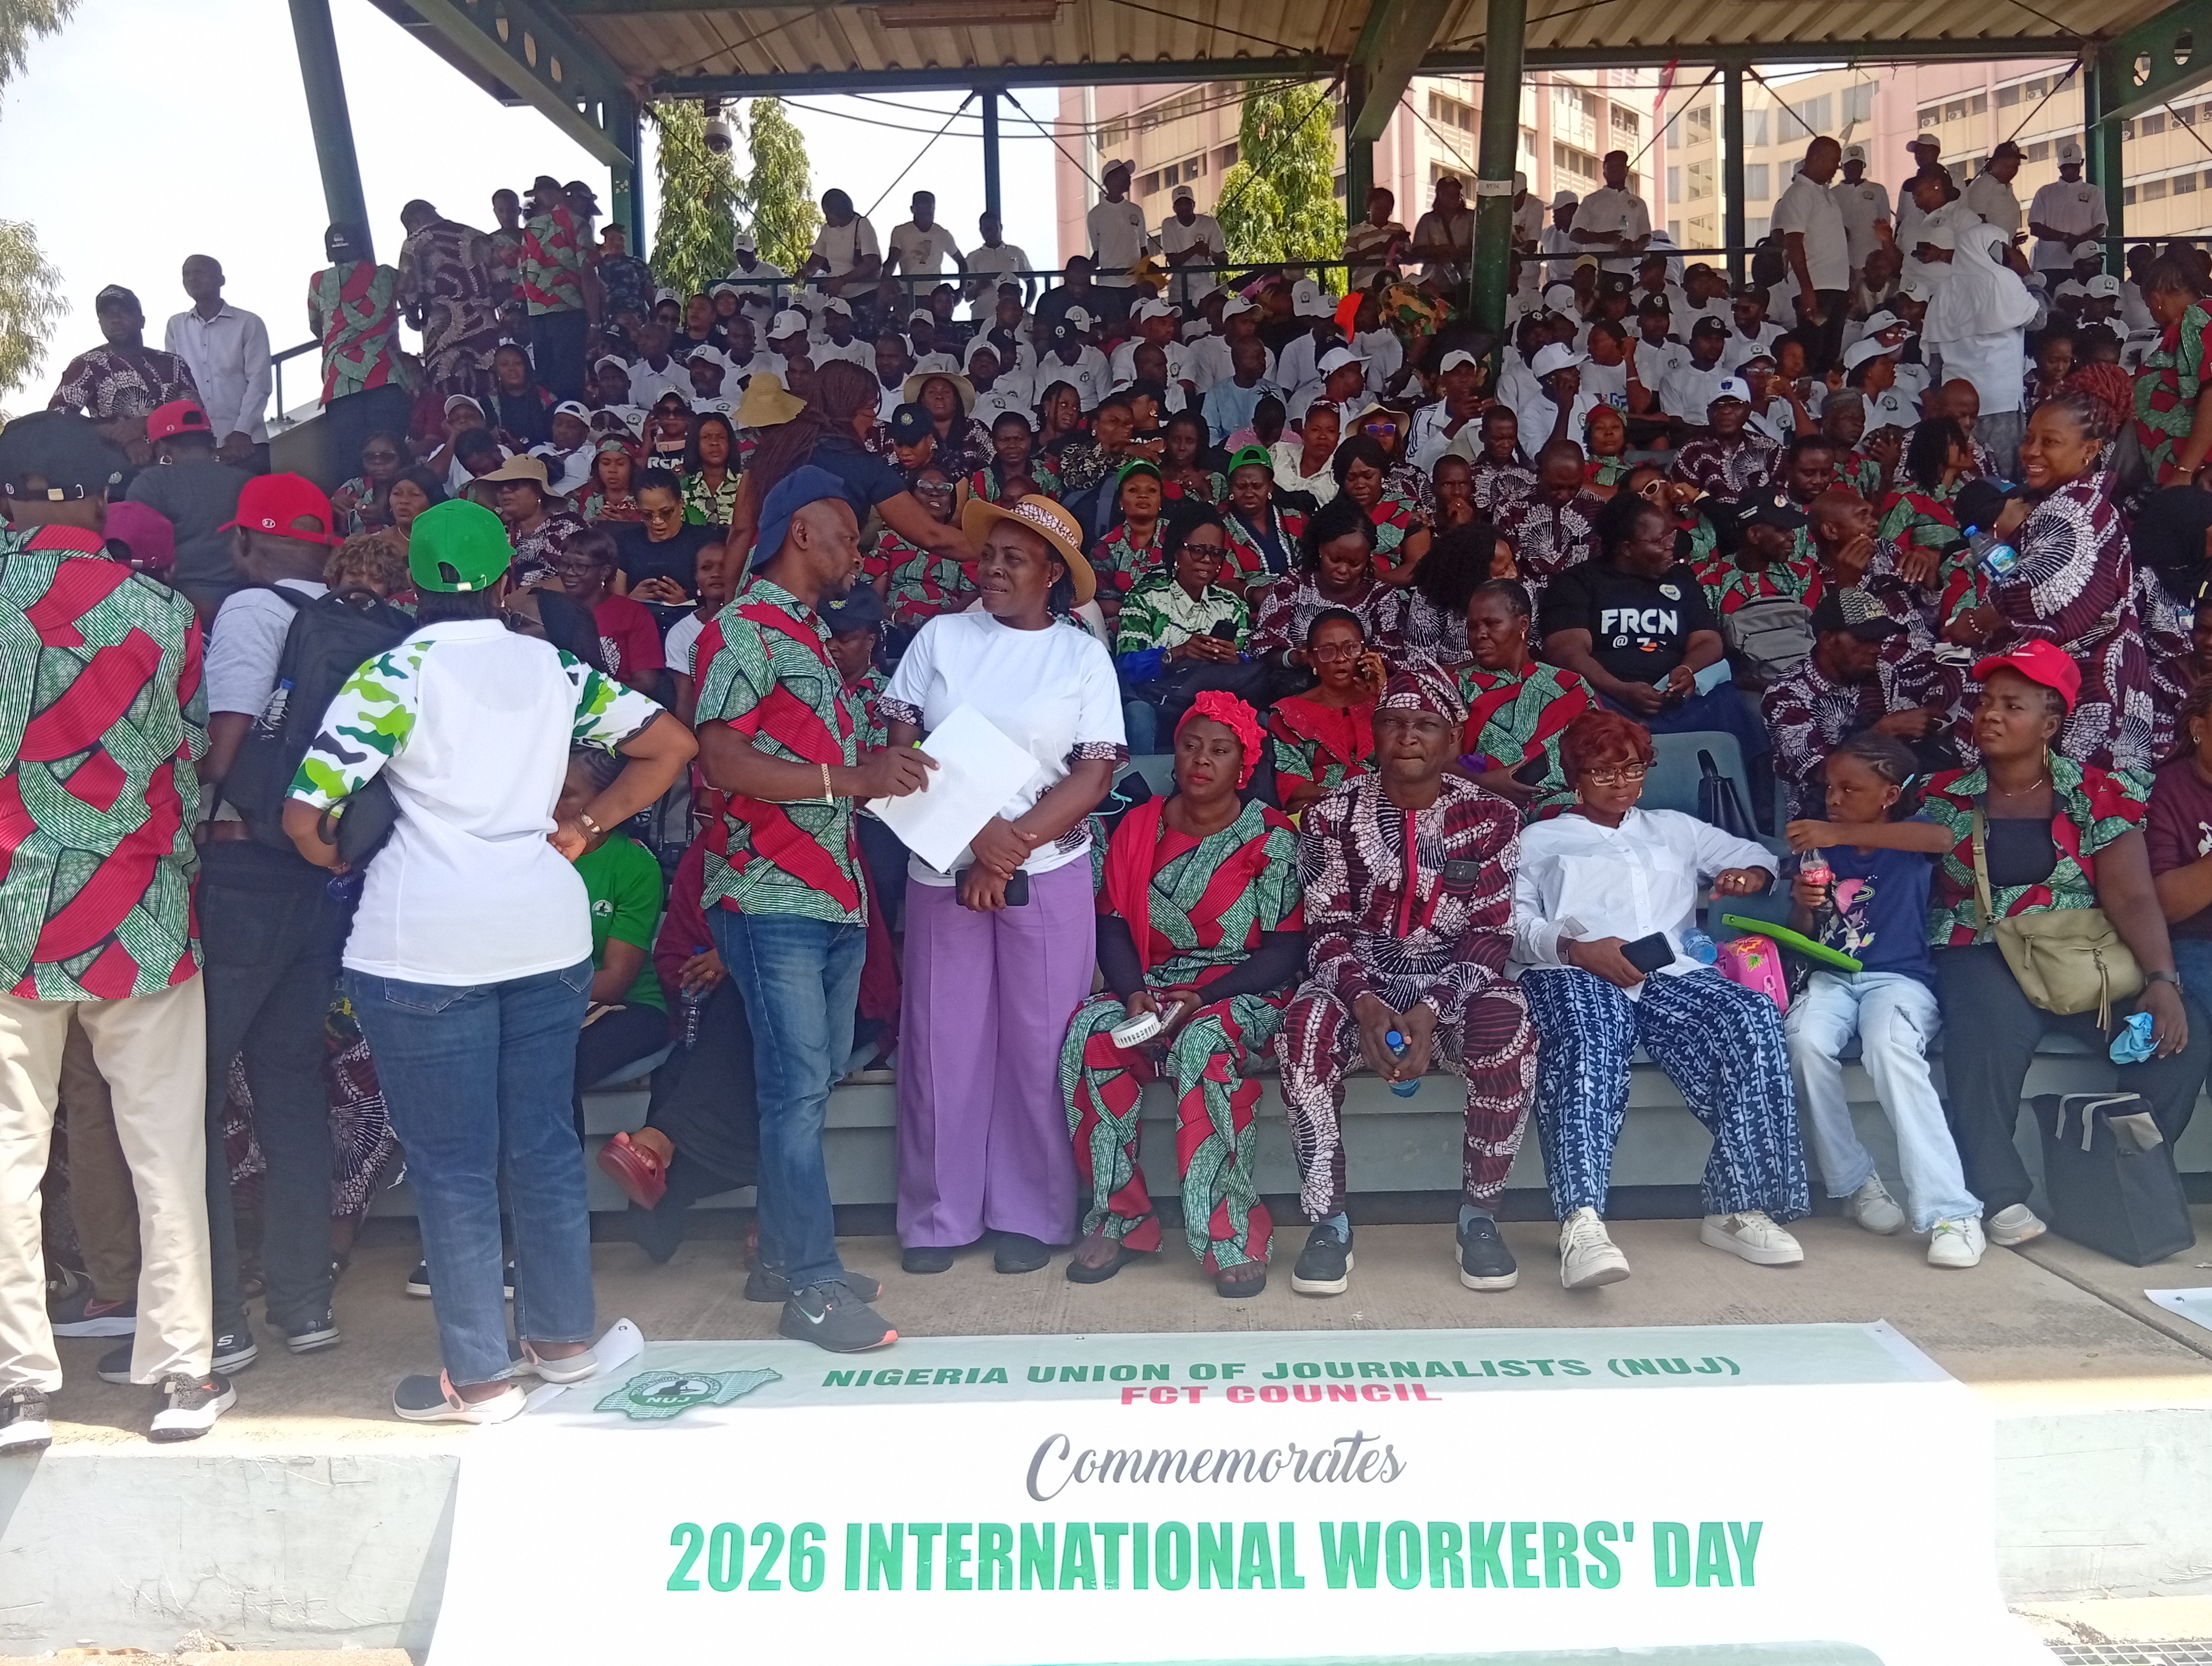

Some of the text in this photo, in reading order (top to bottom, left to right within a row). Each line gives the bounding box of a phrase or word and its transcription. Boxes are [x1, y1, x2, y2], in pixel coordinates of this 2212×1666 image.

[648, 455, 684, 469] RCN
[1601, 608, 1677, 635] FRCN
[1612, 635, 1629, 649] @
[822, 1356, 1741, 1387] NIGERIA UNION OF JOURNALISTS (NUJ)
[1121, 1383, 1443, 1405] FCT COUNCIL
[1026, 1430, 1407, 1501] Commemorates
[666, 1520, 1763, 1592] 2026 INTERNATIONAL WORKERS' DAY
